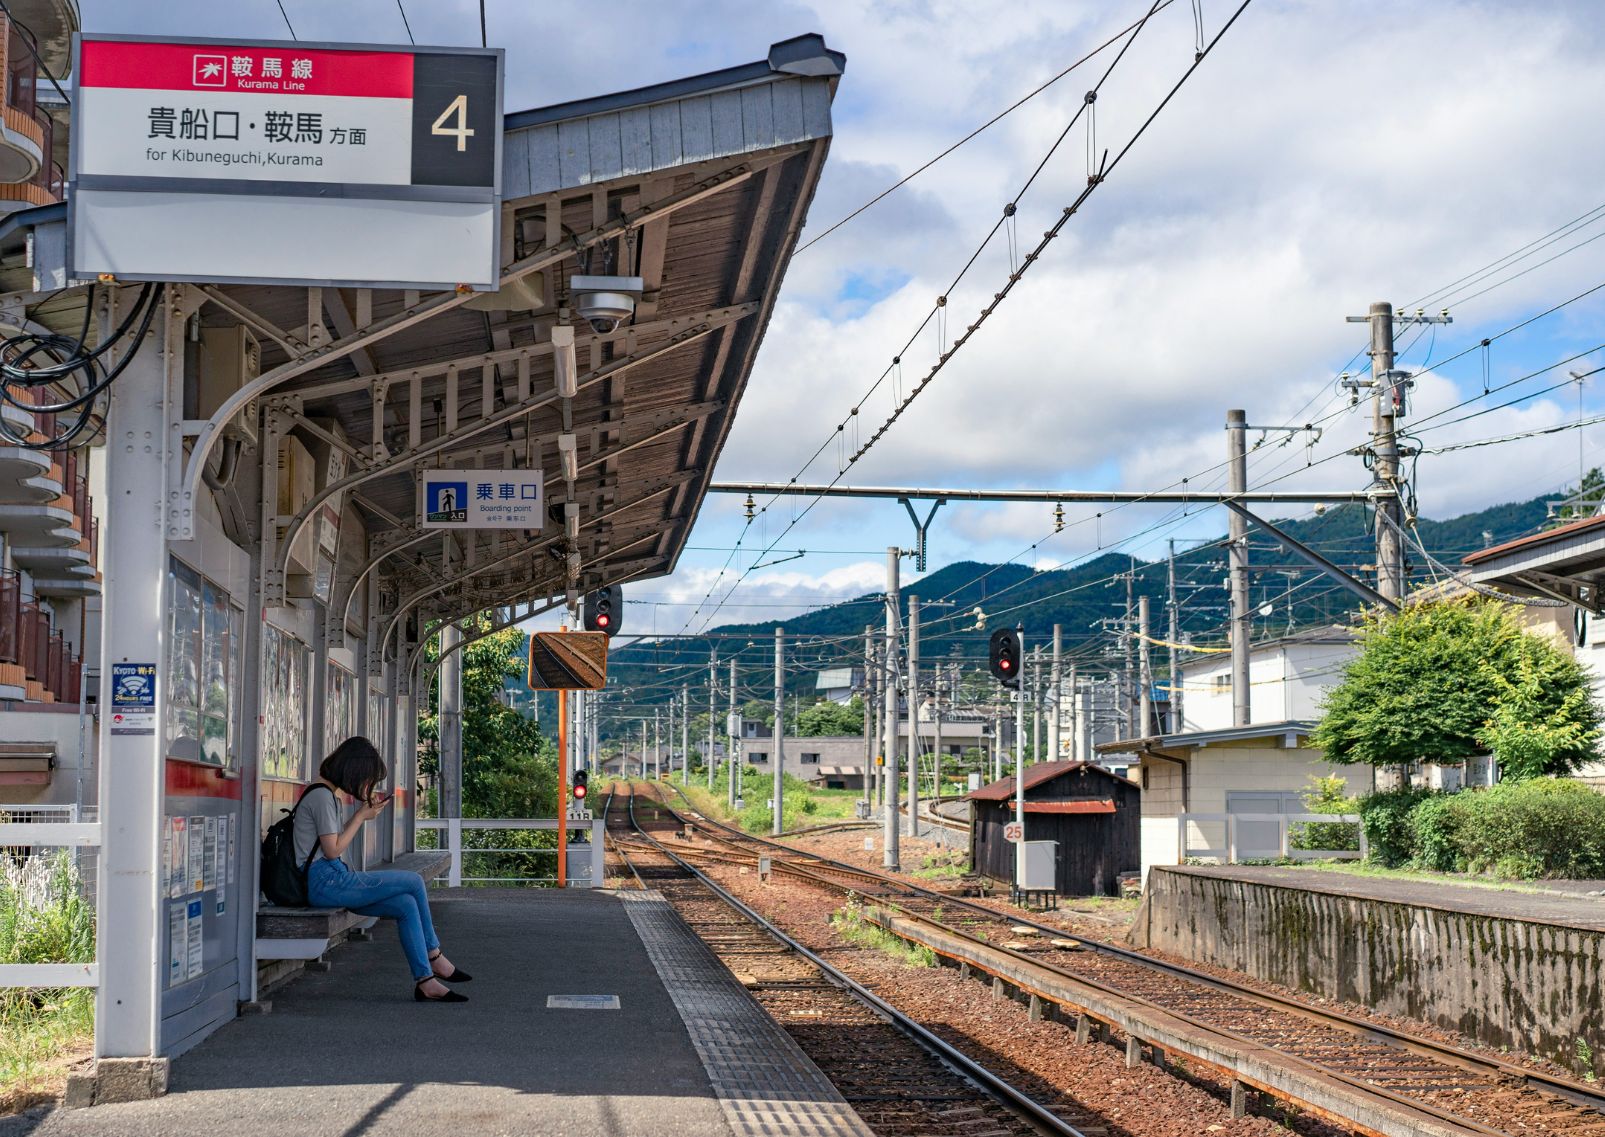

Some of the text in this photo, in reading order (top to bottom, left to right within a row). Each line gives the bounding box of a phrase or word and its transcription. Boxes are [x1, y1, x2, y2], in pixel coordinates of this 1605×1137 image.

[231, 56, 313, 79] 鞍馬線
[237, 79, 305, 91] Kurama Line
[431, 95, 475, 152] 4
[146, 147, 167, 161] for
[476, 483, 536, 500] 乗車口
[480, 504, 532, 513] Boarding point
[1006, 826, 1022, 839] 25
